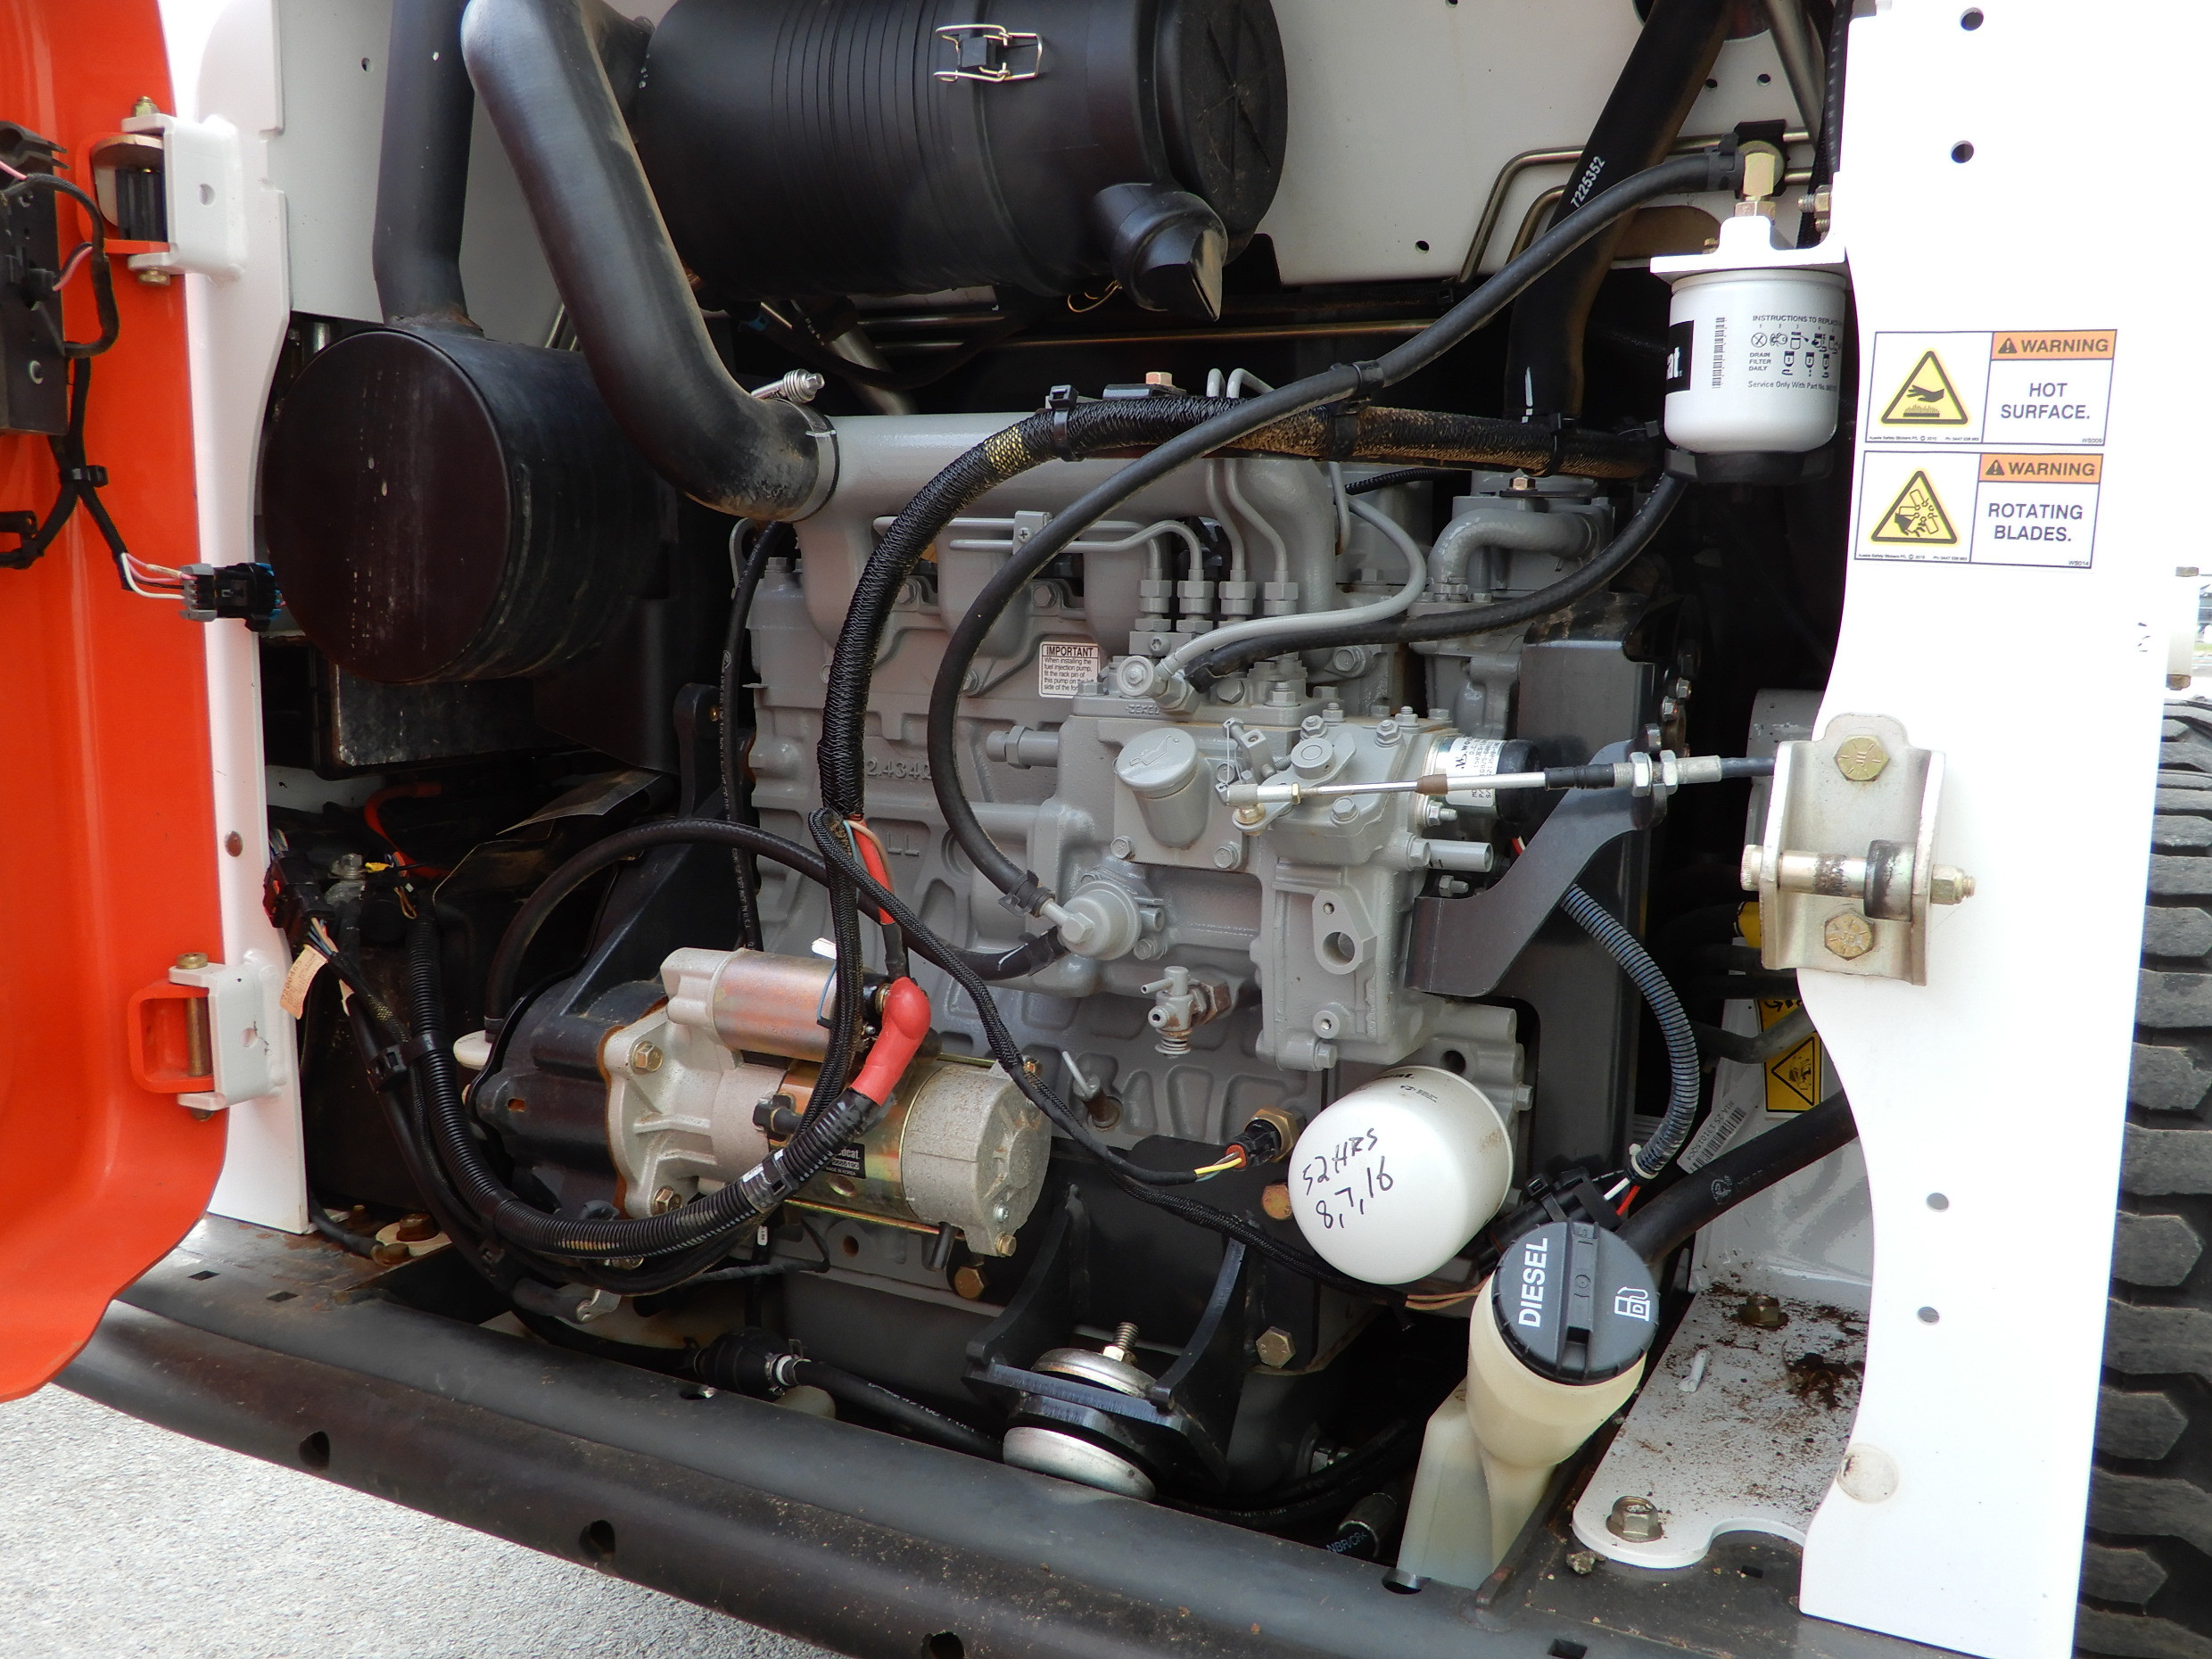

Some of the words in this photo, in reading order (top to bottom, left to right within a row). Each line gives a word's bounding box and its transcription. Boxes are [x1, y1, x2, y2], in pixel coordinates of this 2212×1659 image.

[1570, 155, 1605, 208] 7225352
[1752, 315, 1808, 323] INSTRUCTIONS
[2020, 338, 2109, 353] WARNING
[1747, 381, 1774, 389] Service
[1776, 381, 1791, 390] Only
[2029, 383, 2068, 398] HOT
[2001, 404, 2091, 420] SURFACE.
[2008, 461, 2095, 476] WARNING
[1987, 502, 2084, 520] ROTATING
[1993, 524, 2072, 542] BLADES.
[1046, 646, 1094, 657] IMPORTANT
[1060, 657, 1083, 665] installing
[1518, 1237, 1548, 1328] DIESEL
